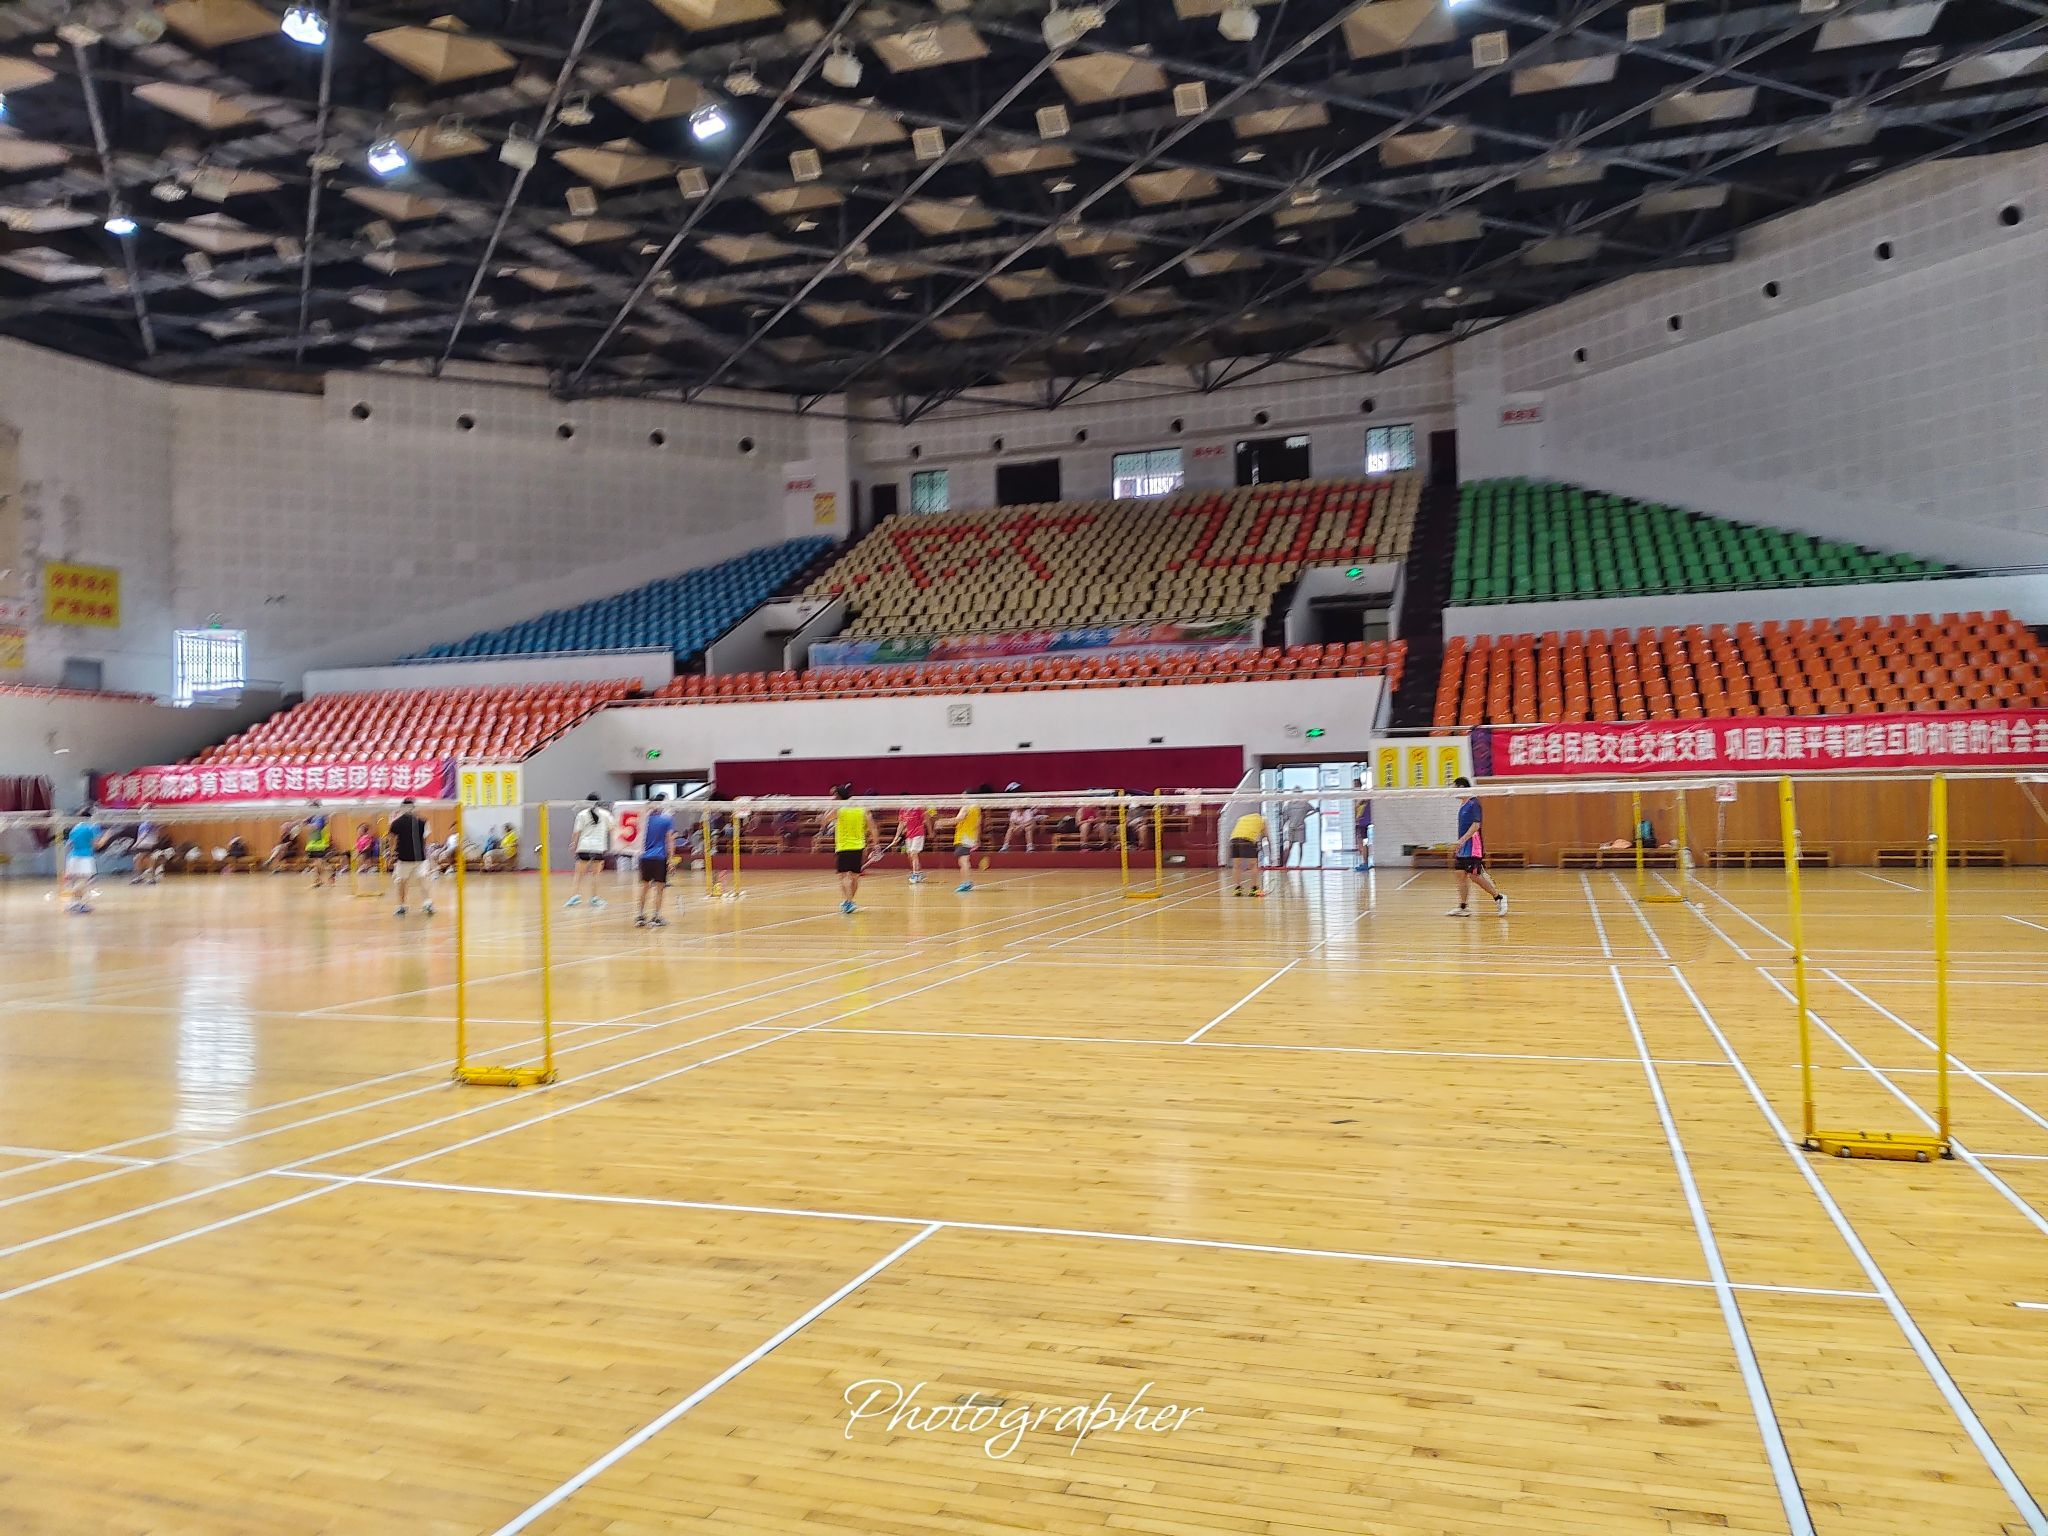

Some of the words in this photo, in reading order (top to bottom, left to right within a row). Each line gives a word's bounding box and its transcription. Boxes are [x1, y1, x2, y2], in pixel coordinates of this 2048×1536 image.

[265, 764, 434, 792] 促进民族团结进步
[619, 811, 639, 842] 5
